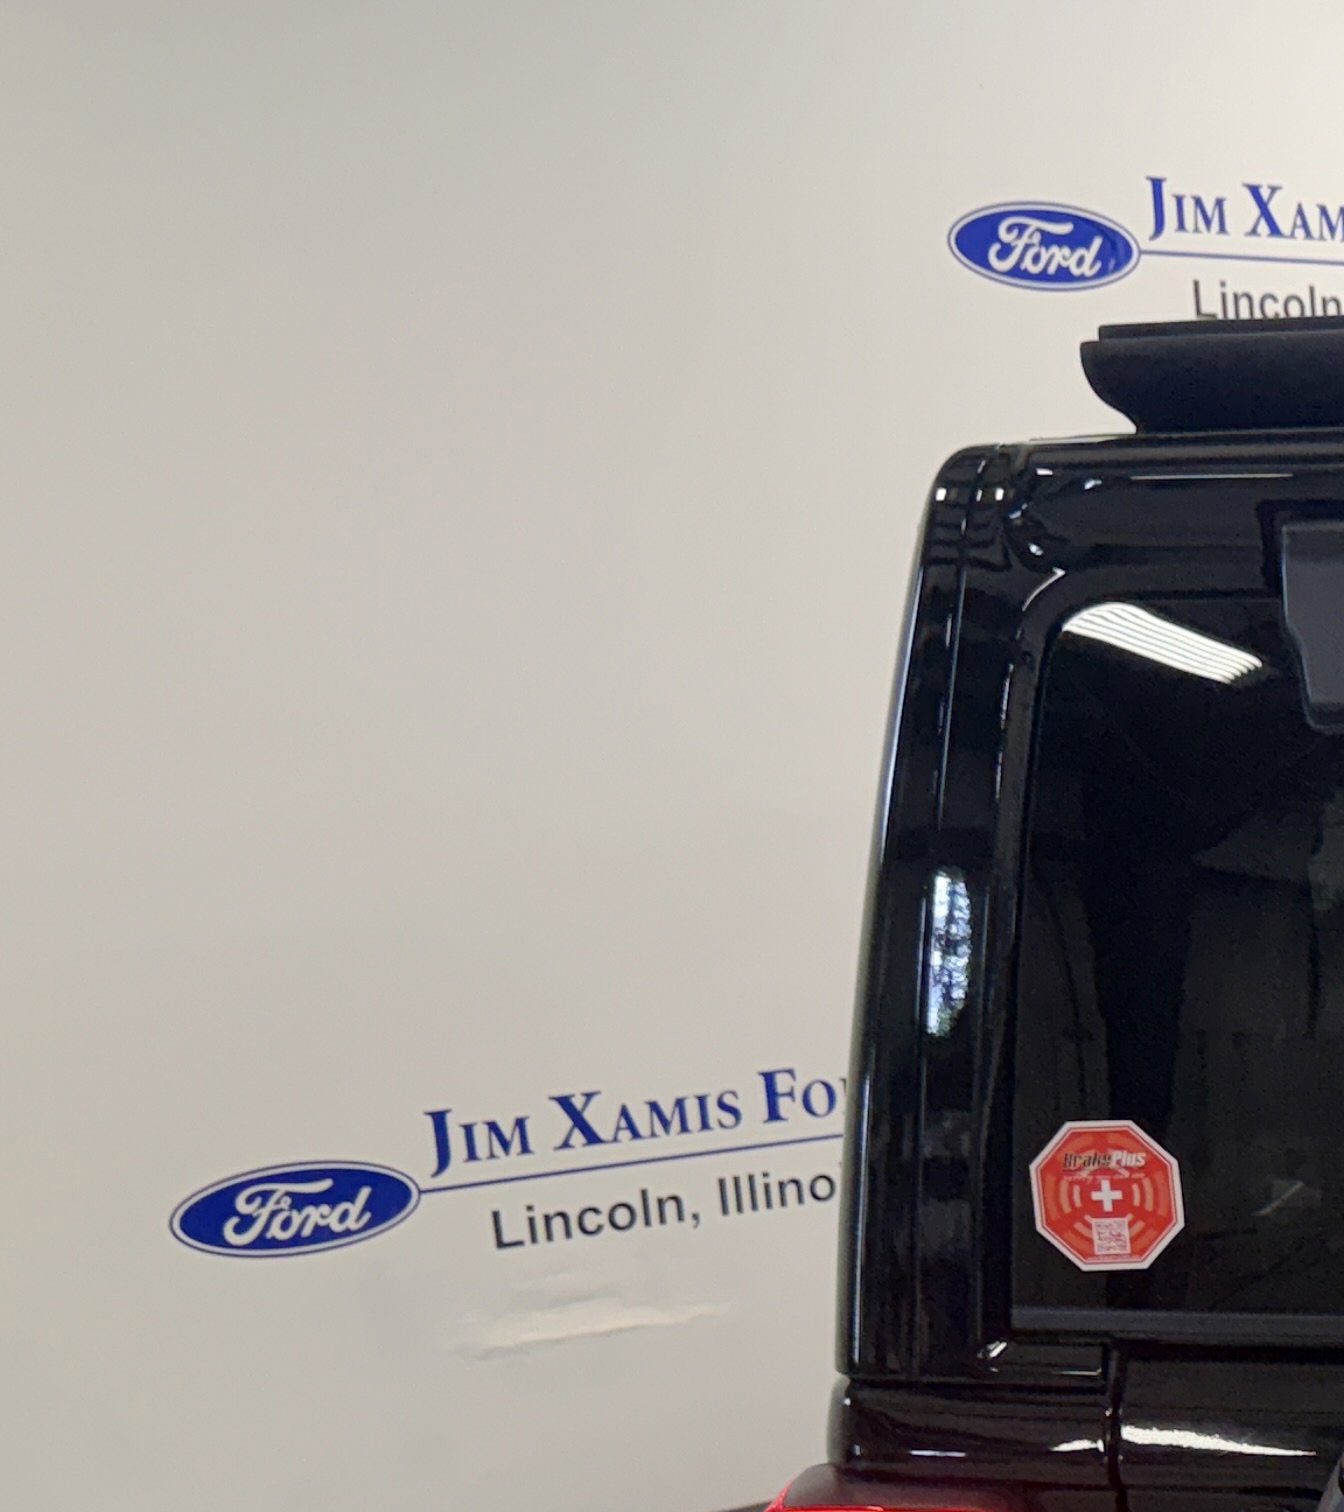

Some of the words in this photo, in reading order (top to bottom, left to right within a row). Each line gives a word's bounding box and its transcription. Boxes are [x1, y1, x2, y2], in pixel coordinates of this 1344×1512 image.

[1146, 176, 1226, 240] JIM
[988, 216, 1101, 277] Ford
[424, 1110, 531, 1178] JIM
[548, 1091, 743, 1151] XAMIS
[757, 1068, 847, 1124] FO
[222, 1178, 371, 1247] Ford
[490, 1188, 700, 1250] Lincoln,
[718, 1171, 836, 1216] Illino
